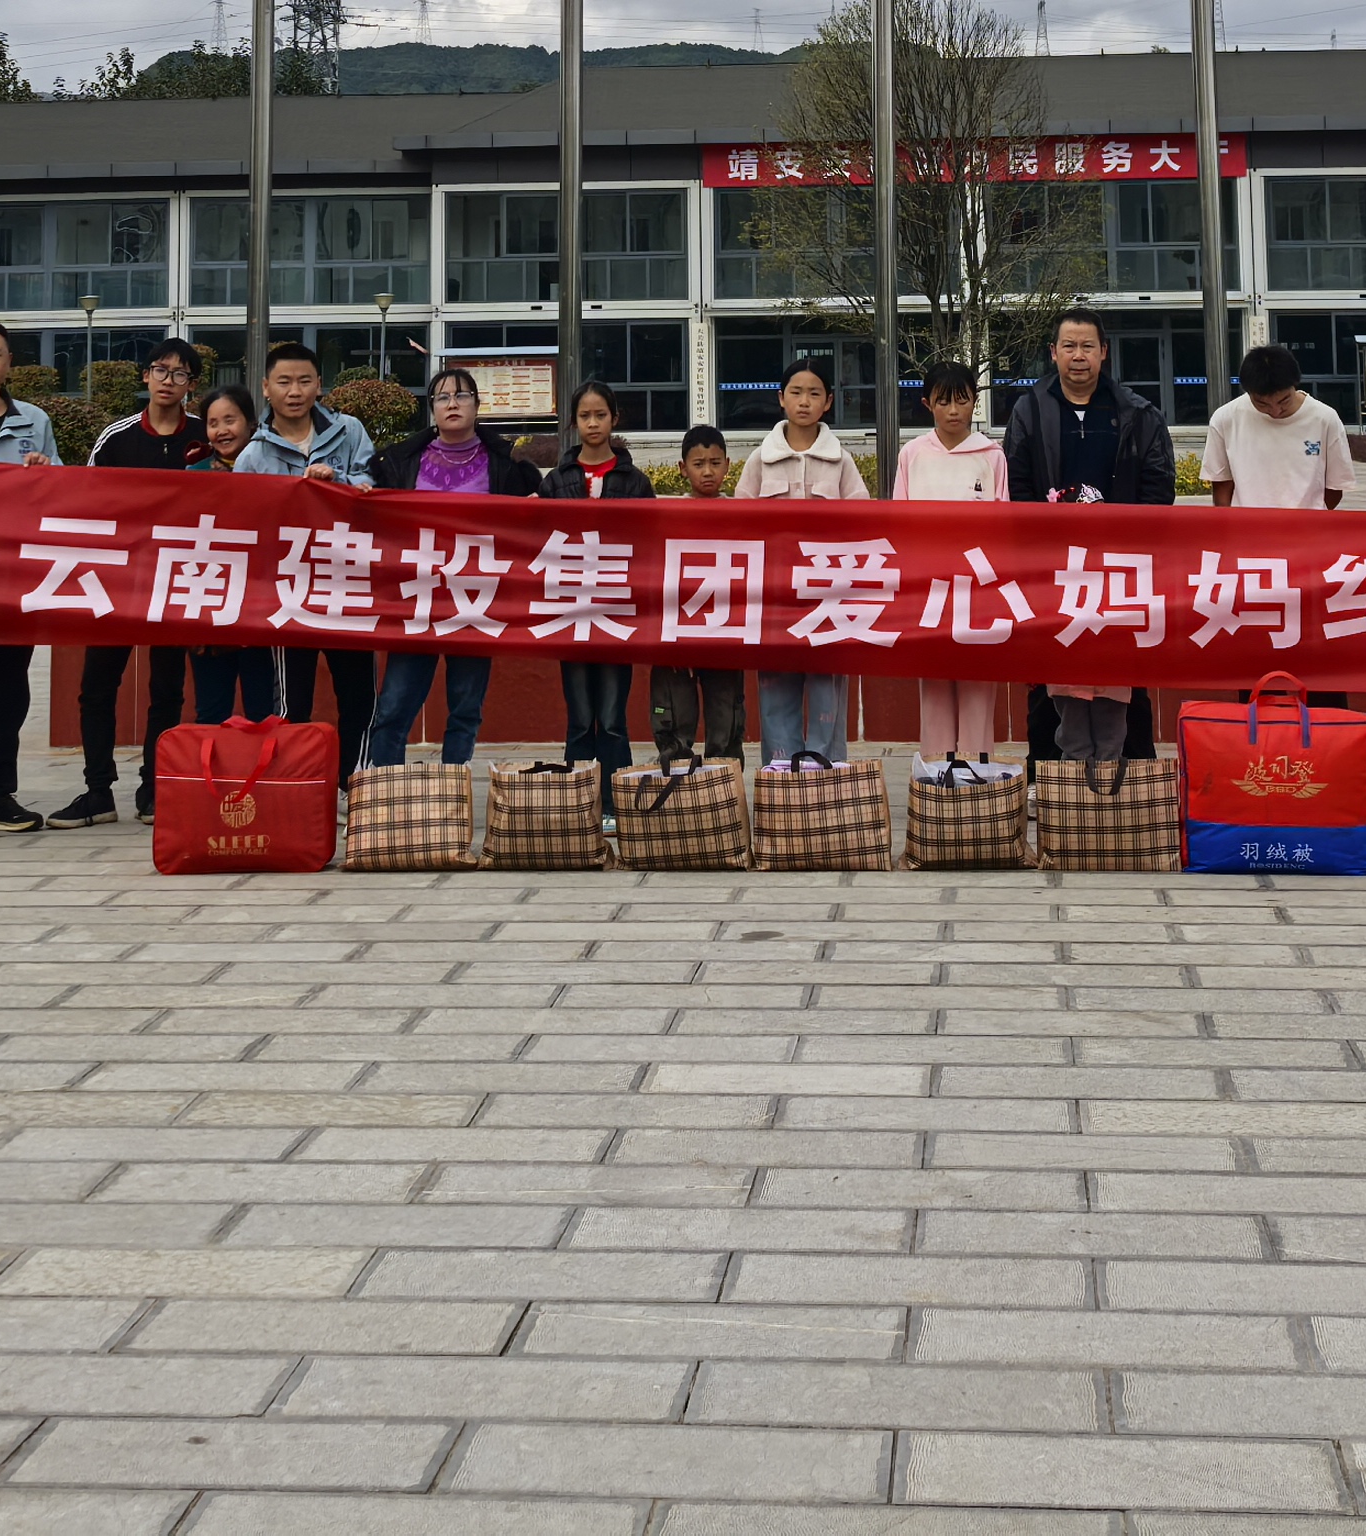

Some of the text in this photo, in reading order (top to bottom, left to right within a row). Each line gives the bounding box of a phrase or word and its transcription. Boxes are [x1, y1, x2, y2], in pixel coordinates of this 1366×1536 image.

[728, 140, 1229, 181] 靖安民服务大
[207, 834, 271, 849] SLEEP
[1239, 842, 1315, 863] 羽绒被
